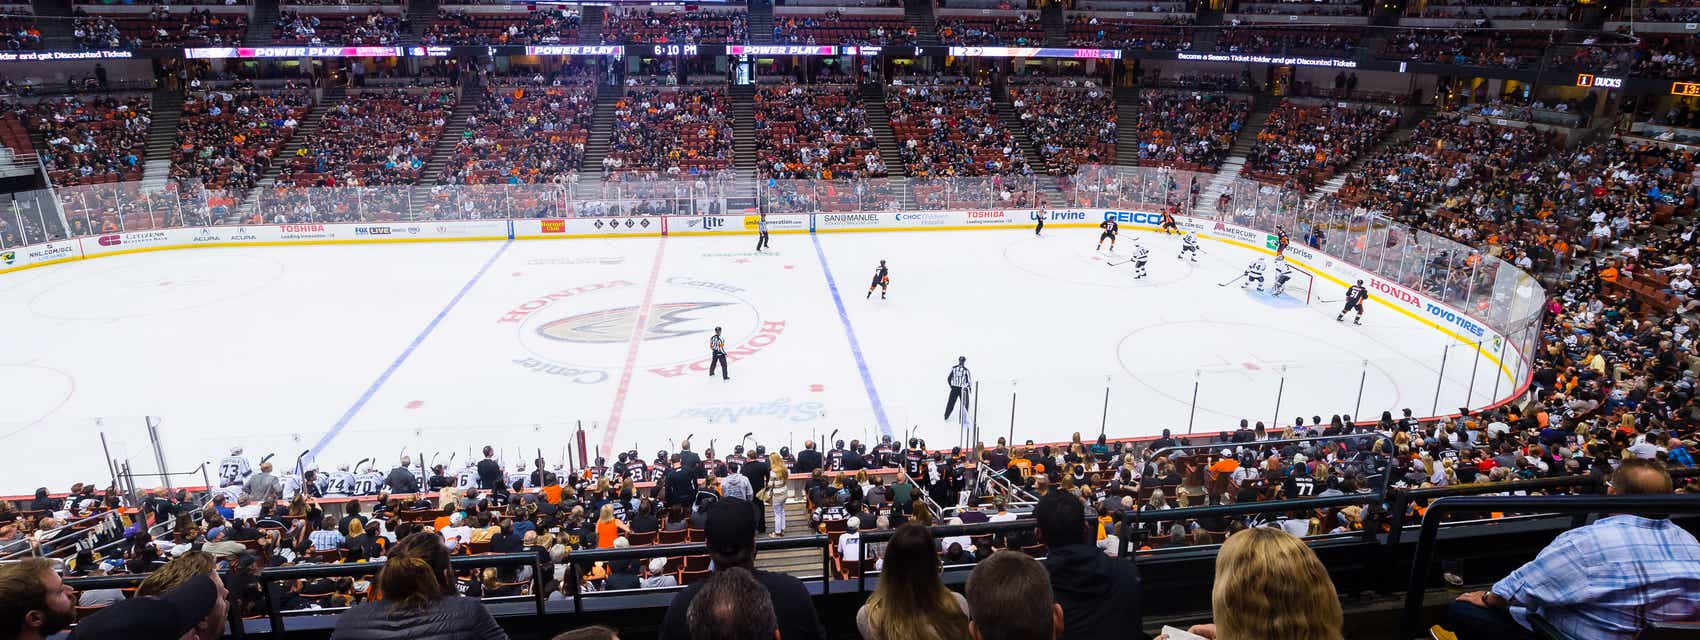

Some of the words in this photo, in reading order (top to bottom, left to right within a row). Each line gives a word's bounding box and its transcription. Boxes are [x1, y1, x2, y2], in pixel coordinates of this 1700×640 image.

[39, 53, 54, 61] get
[54, 51, 102, 60] Discounted
[102, 51, 133, 59] Tickets
[254, 48, 306, 57] POWER
[308, 48, 342, 57] PLAY
[535, 46, 580, 55] POWER
[583, 46, 616, 55] PLAY
[655, 45, 680, 56] 6:10
[684, 45, 698, 56] PM
[743, 46, 787, 55] POWER
[789, 46, 820, 55] PLAY
[1231, 54, 1250, 62] Ticket
[1250, 55, 1272, 63] Holder
[1285, 57, 1297, 66] get
[1297, 58, 1332, 66] Discounted
[1332, 60, 1357, 68] Tickets
[1595, 77, 1622, 88] DUCKS
[824, 214, 841, 222] SAN
[1051, 210, 1086, 221] Irvine
[1104, 211, 1161, 225] GEICO
[280, 224, 324, 232] TOSHIBA
[703, 217, 724, 230] Lite
[1225, 227, 1257, 239] MERCURY
[665, 276, 748, 293] Center
[1370, 279, 1422, 308] HONDA
[496, 280, 638, 324] HONDA
[1455, 315, 1486, 338] TIRES
[511, 357, 609, 384] Center
[911, 461, 918, 473] 3
[630, 468, 643, 480] 23
[329, 478, 345, 491] 74
[460, 474, 469, 487] 6
[354, 481, 371, 494] 70
[1296, 482, 1314, 496] 77
